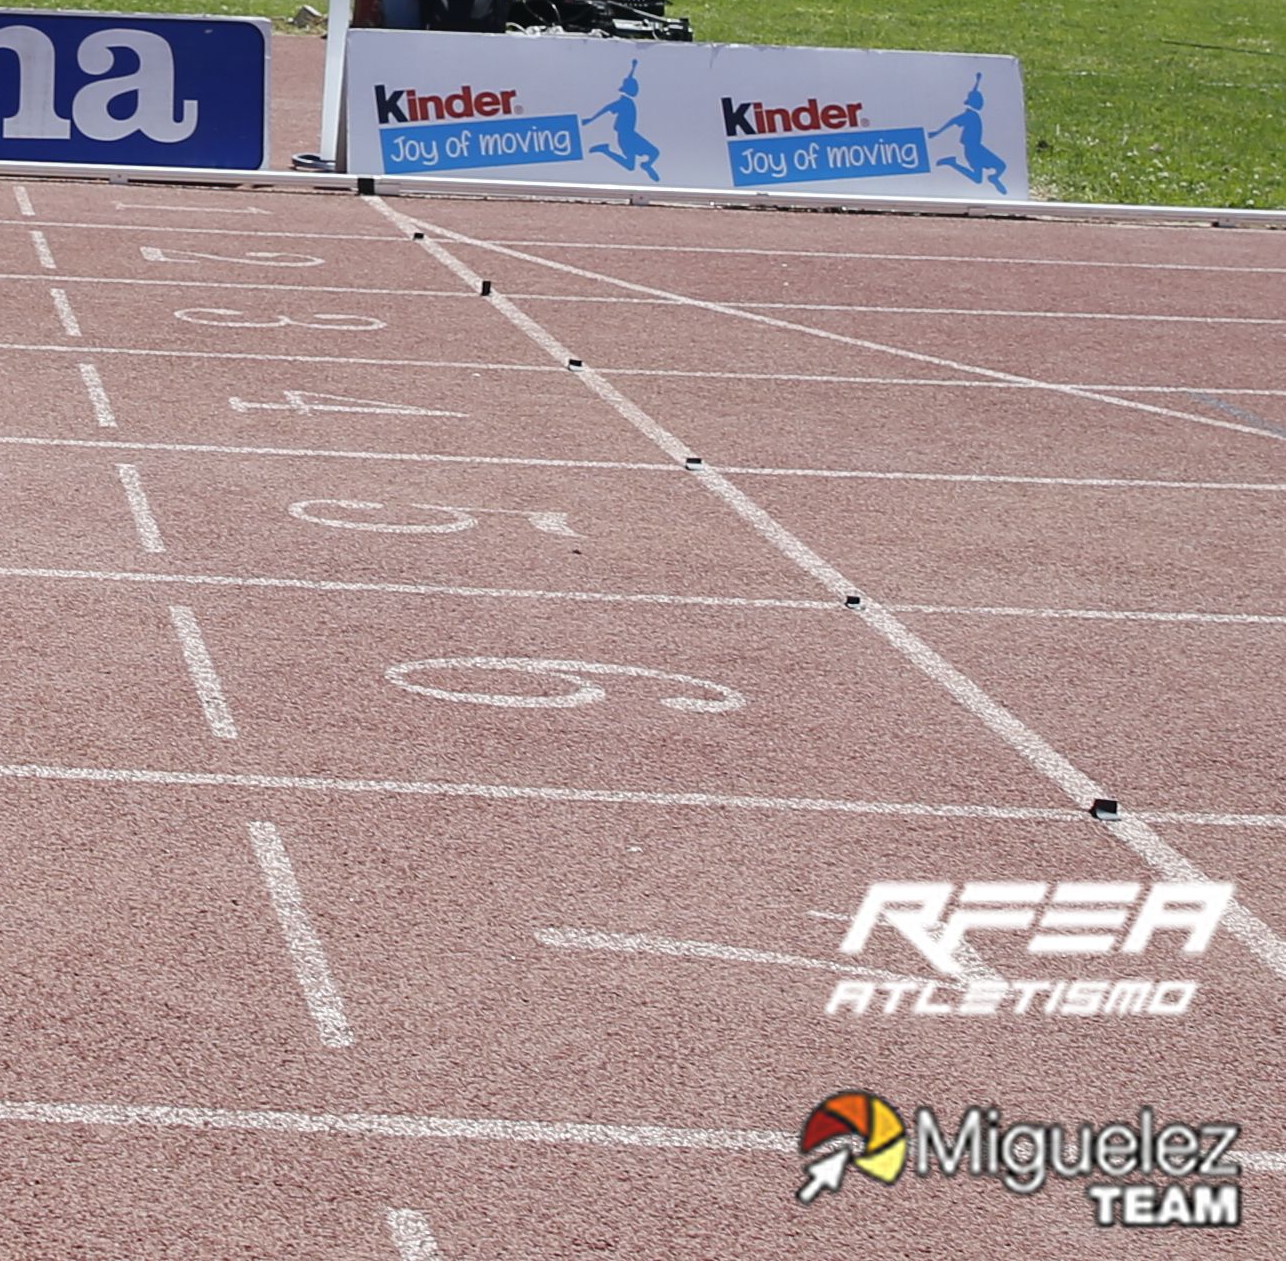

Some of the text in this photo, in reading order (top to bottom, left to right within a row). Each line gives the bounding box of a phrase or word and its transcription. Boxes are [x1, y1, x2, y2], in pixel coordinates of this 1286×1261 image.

[390, 125, 572, 166] Joy of moving
[739, 138, 920, 178] Joy of moving
